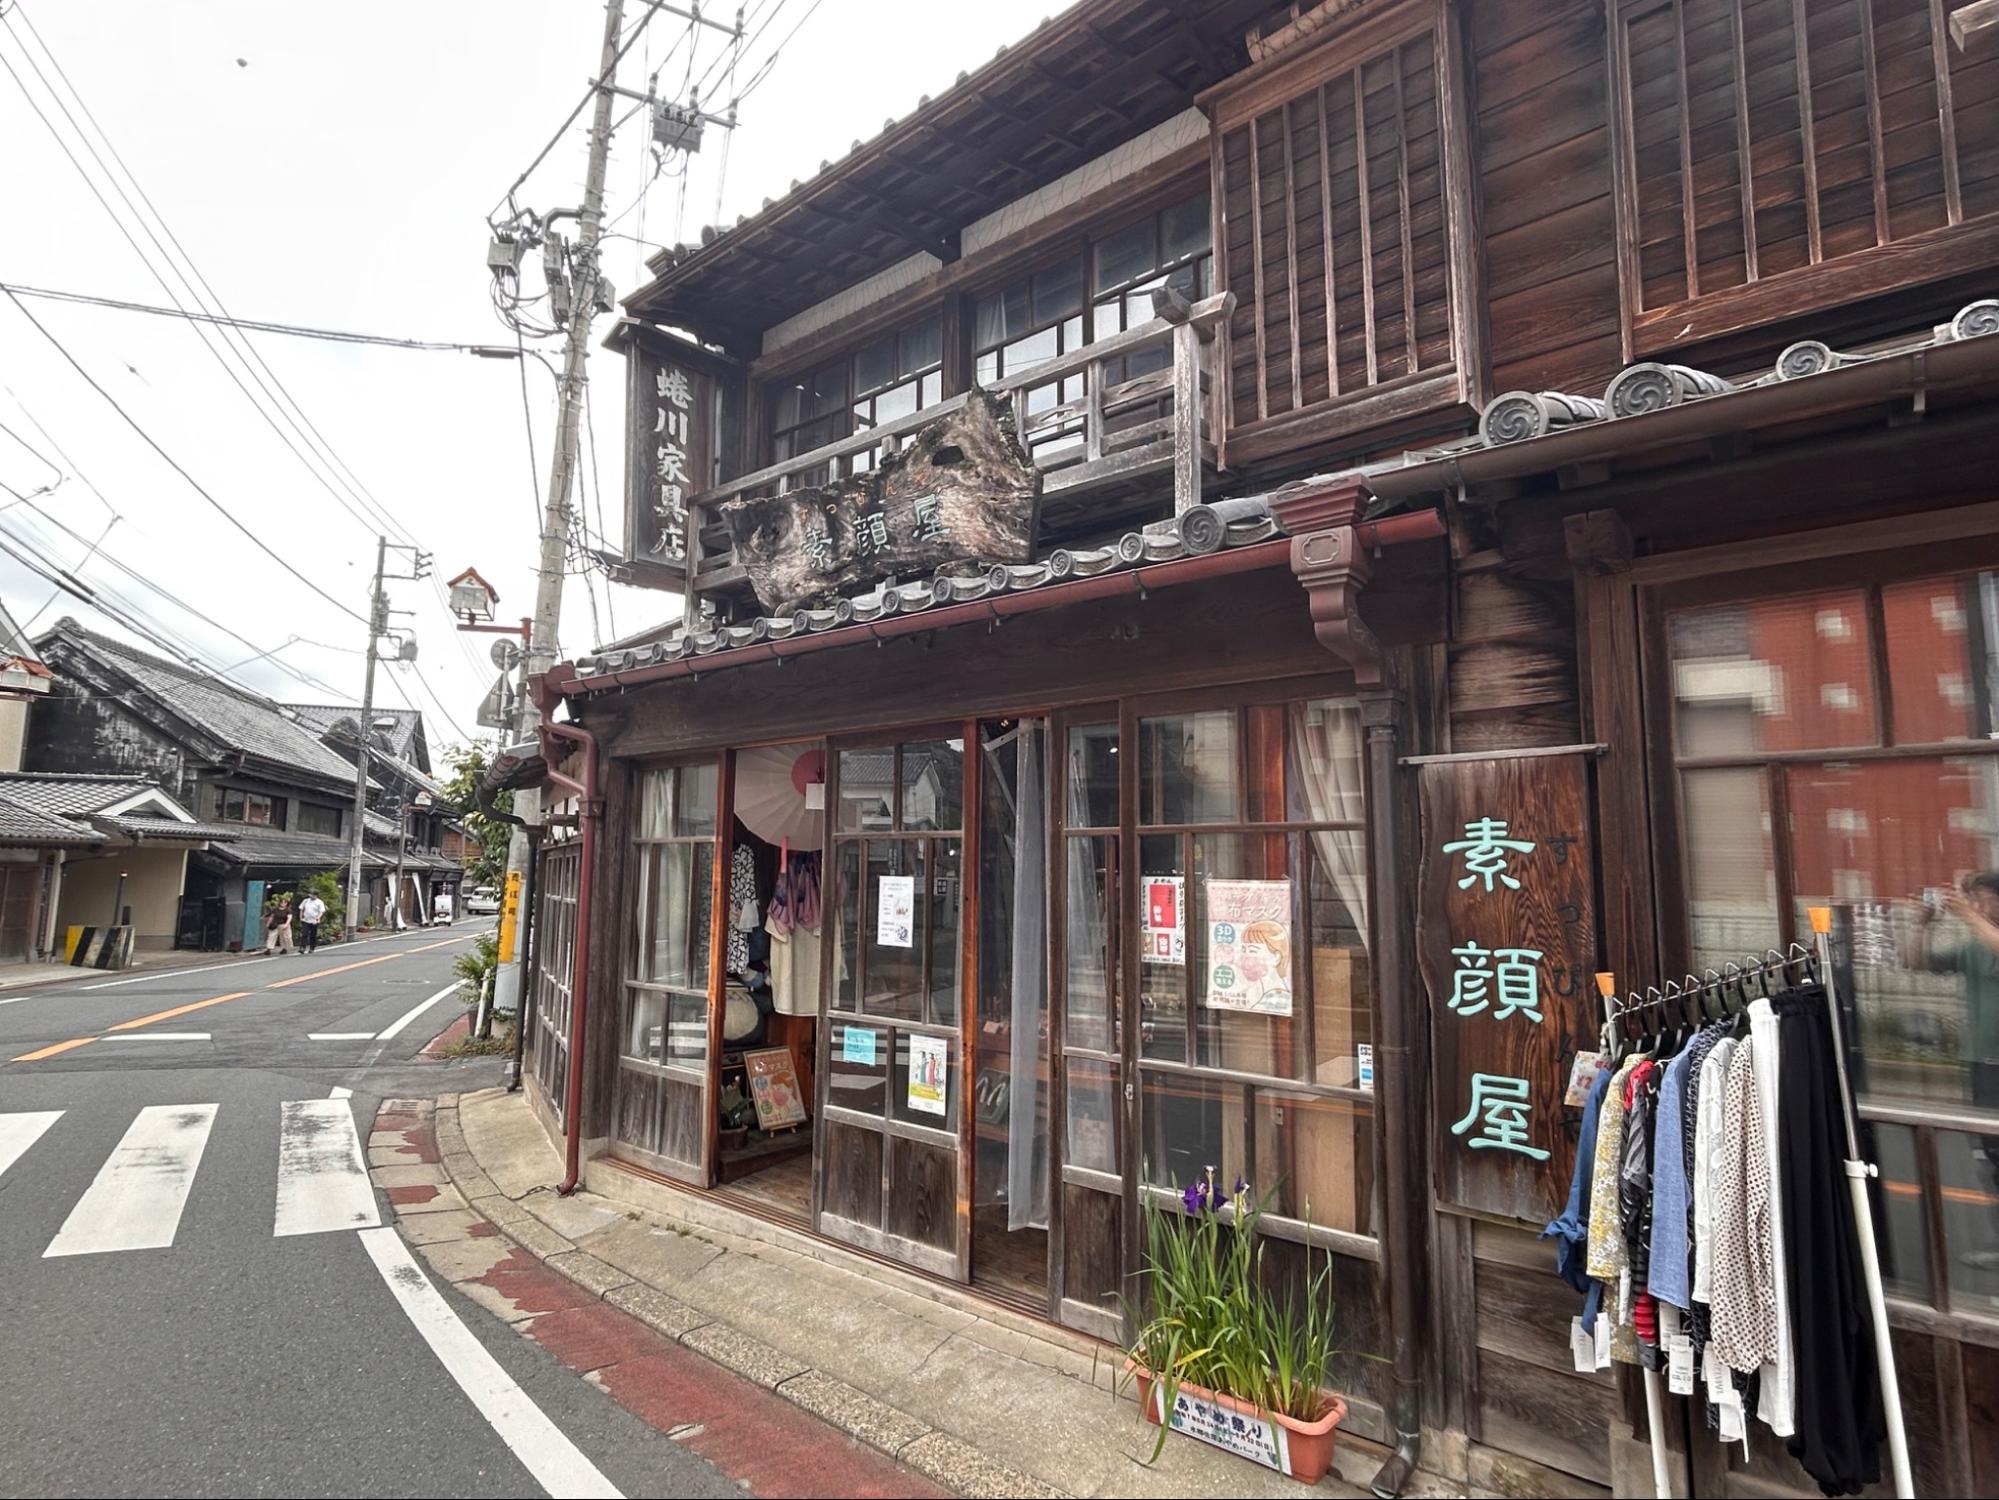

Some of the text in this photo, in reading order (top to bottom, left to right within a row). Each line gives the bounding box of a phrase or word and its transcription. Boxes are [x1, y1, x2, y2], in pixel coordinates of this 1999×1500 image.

[649, 367, 693, 562] 蜷川家具店
[801, 493, 951, 568] 素顔屋
[1216, 925, 1232, 935] 3D
[1442, 816, 1552, 1162] 素顔屋
[1177, 1396, 1262, 1439] あやめ祭り
